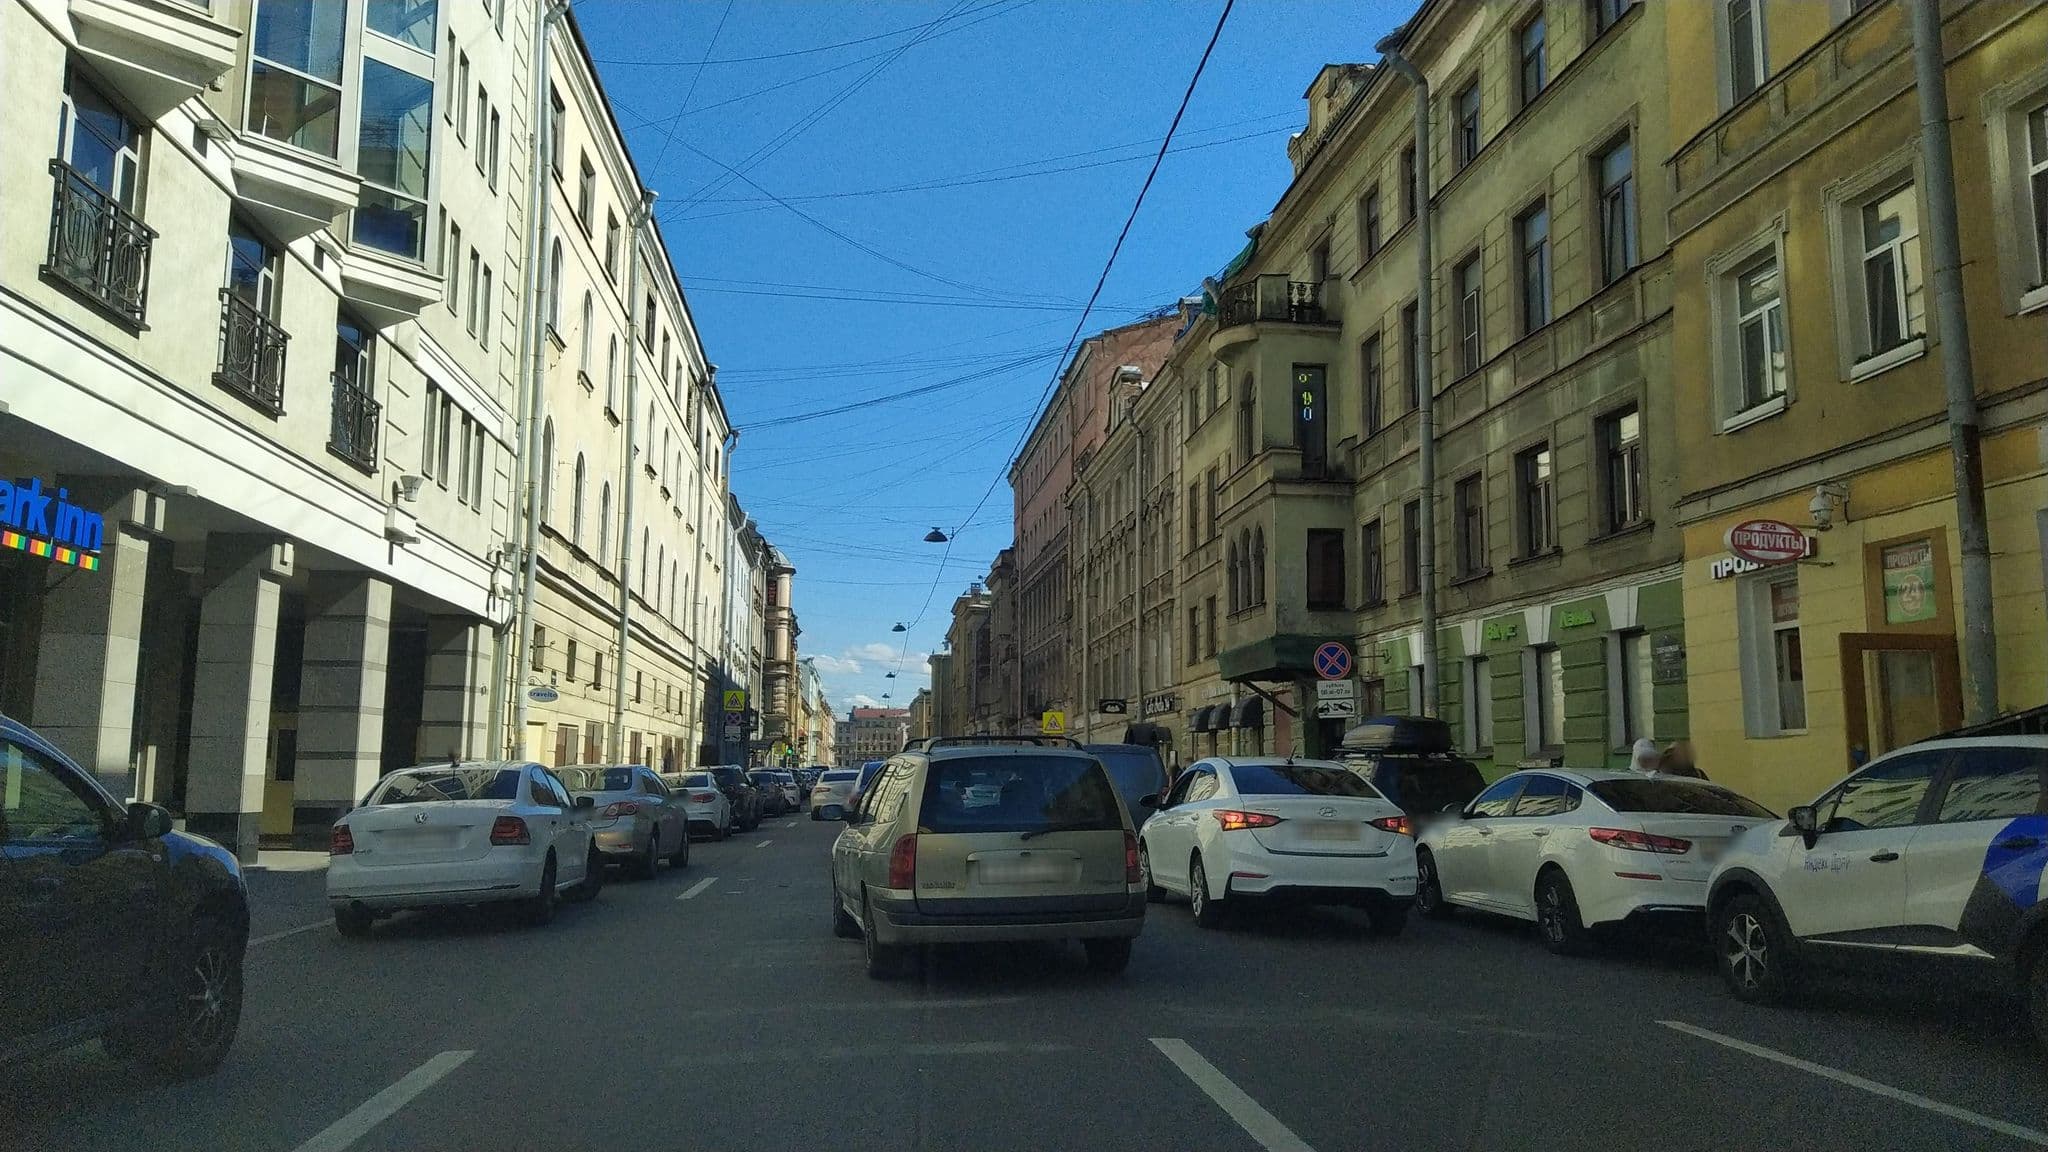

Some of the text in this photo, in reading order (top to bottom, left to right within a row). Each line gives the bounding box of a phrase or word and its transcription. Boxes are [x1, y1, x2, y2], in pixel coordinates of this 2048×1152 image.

[54, 487, 105, 550] inn
[1760, 523, 1777, 531] 24
[1734, 531, 1804, 550] ПРОДУКТЫ
